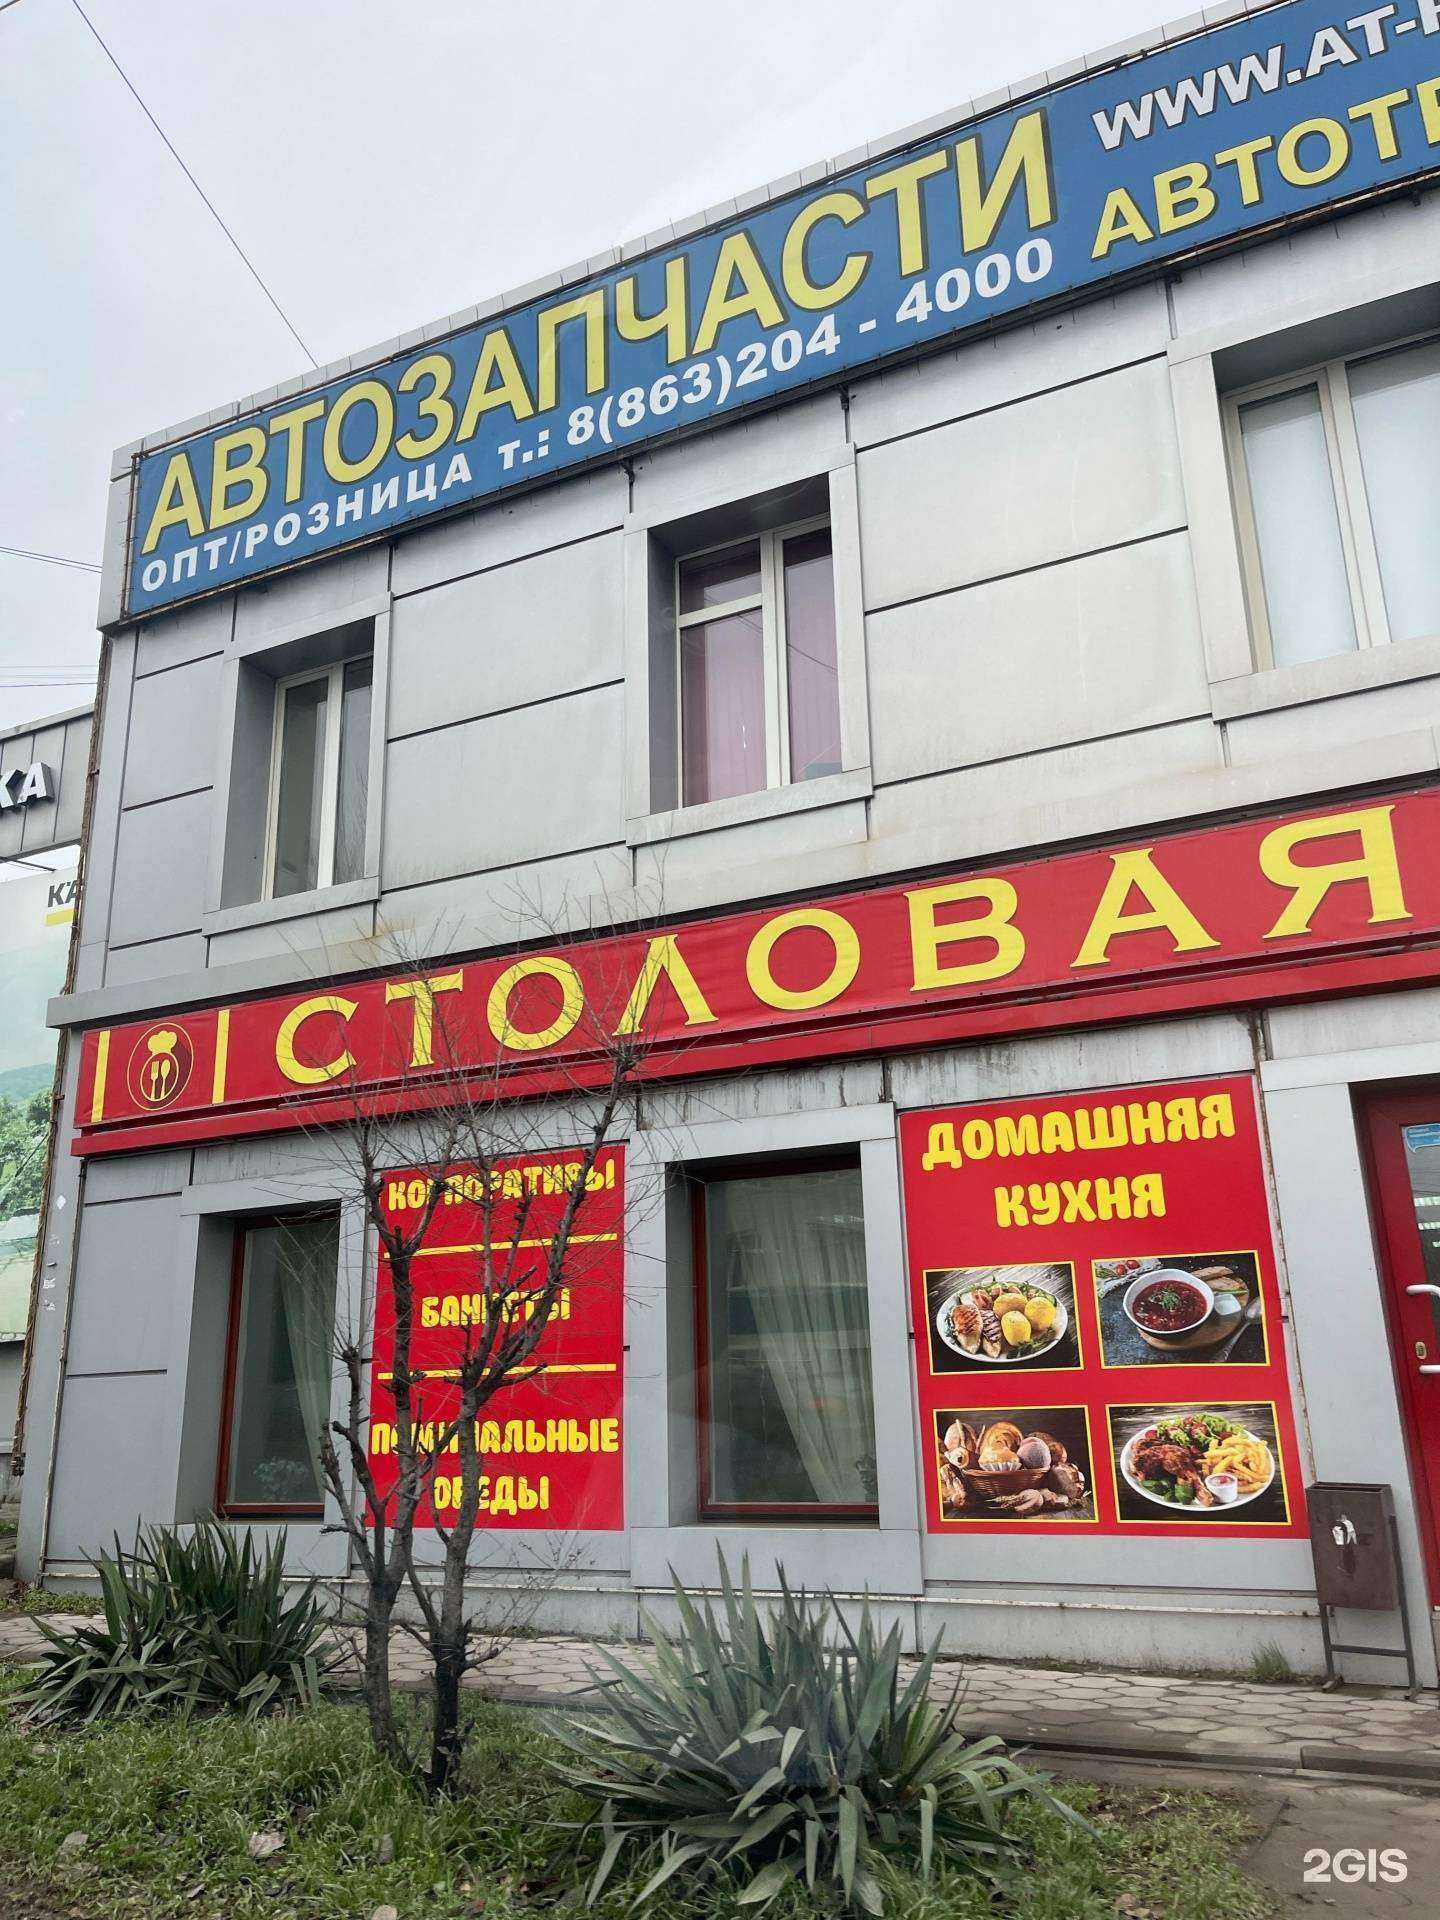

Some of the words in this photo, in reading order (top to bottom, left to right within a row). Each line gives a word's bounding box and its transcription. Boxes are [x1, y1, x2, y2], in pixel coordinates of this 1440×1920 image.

[141, 111, 1055, 555] АВТОЗАПЧАСТИ
[141, 453, 473, 592] ОПТ/РОЗНИЦА
[895, 237, 1054, 325] 4000
[275, 803, 1414, 1085] СТОЛОВАЯ
[921, 1093, 1236, 1172] ДОМАШНЯЯ
[388, 1158, 615, 1212] КОПОРАТИВЫ
[993, 1173, 1167, 1229] КУХНЯ
[371, 1417, 619, 1455] ПМИАЛЬНЫЕ
